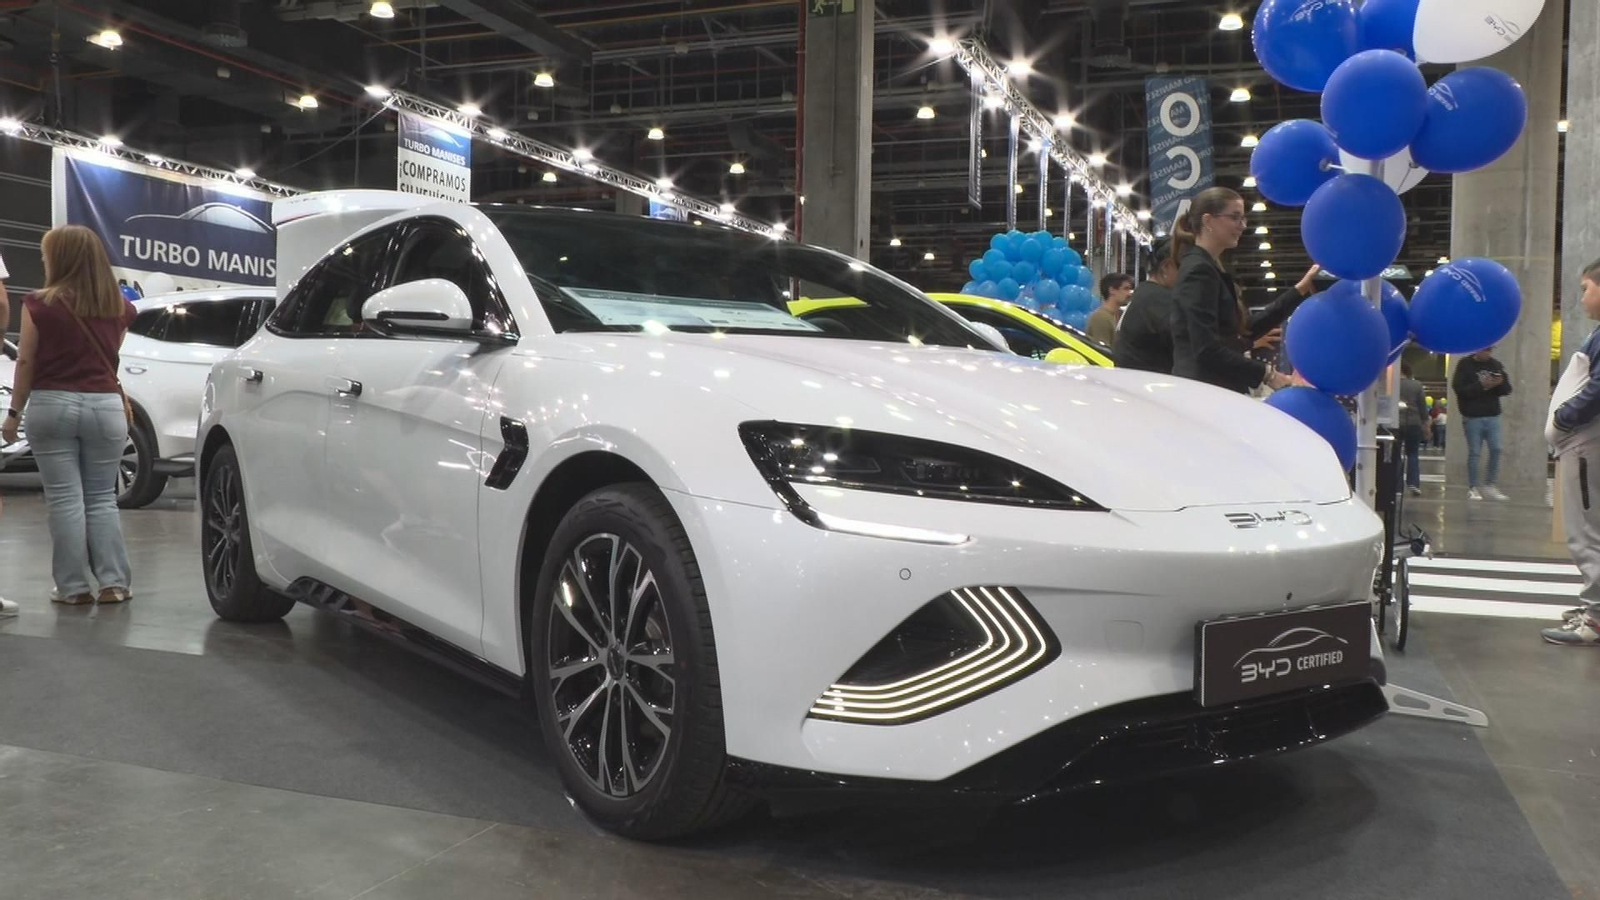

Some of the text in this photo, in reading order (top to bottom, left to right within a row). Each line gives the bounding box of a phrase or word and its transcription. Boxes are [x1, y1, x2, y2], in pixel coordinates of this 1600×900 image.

[404, 138, 466, 166] TURBO MANISES
[399, 160, 466, 192] ¡COMPRAMOS
[119, 235, 277, 279] TURBO MANIS
[1224, 509, 1313, 529] BYD
[1241, 650, 1344, 683] BYD CERTIFIED
